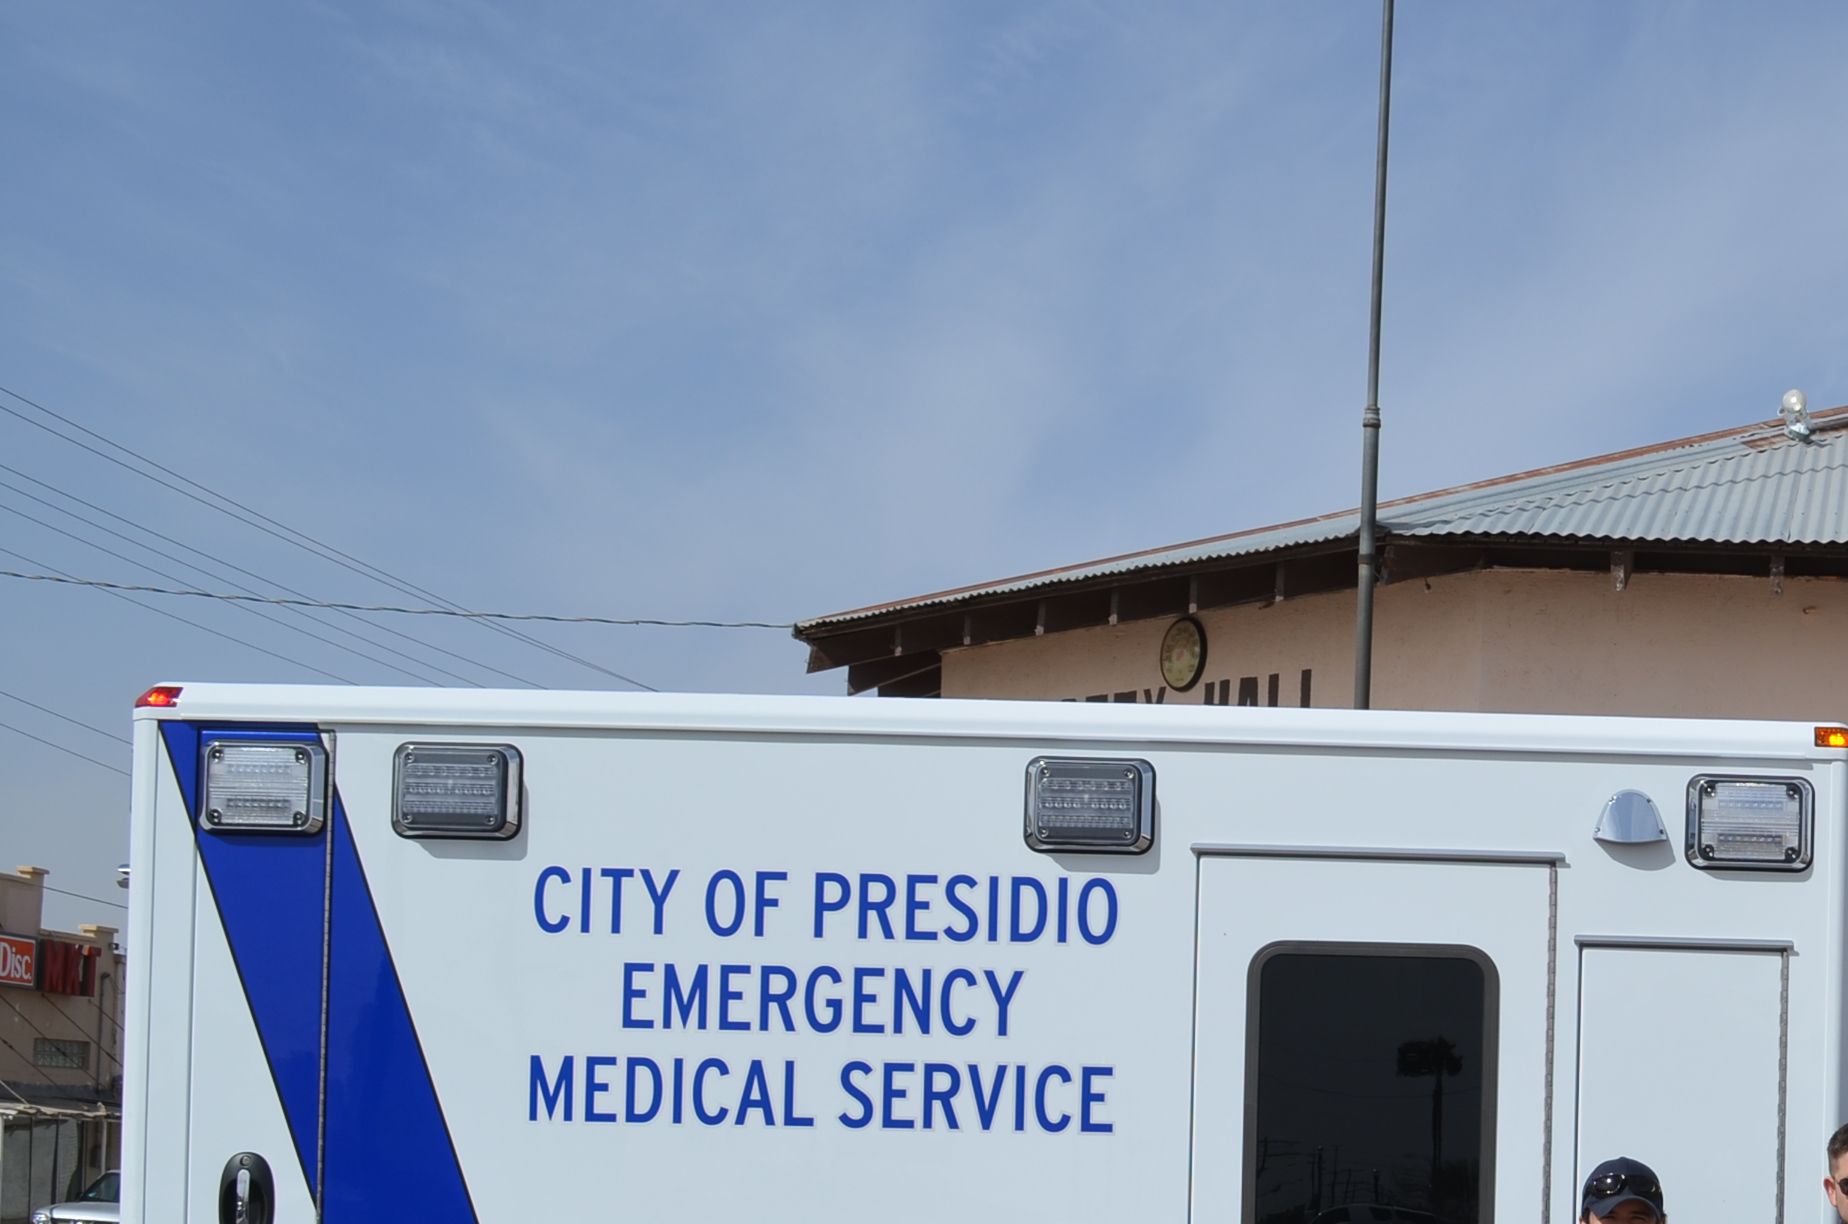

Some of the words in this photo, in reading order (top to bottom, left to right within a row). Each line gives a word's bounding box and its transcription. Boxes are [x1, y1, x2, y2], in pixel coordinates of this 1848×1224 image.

[534, 865, 681, 935] CITY
[705, 869, 788, 937] OF
[813, 872, 1119, 945] PRESIDIO
[44, 939, 102, 997] MKT
[621, 962, 1025, 1037] EMERGENCY
[528, 1055, 815, 1127] MEDICAL
[837, 1061, 1114, 1133] SERVICE
